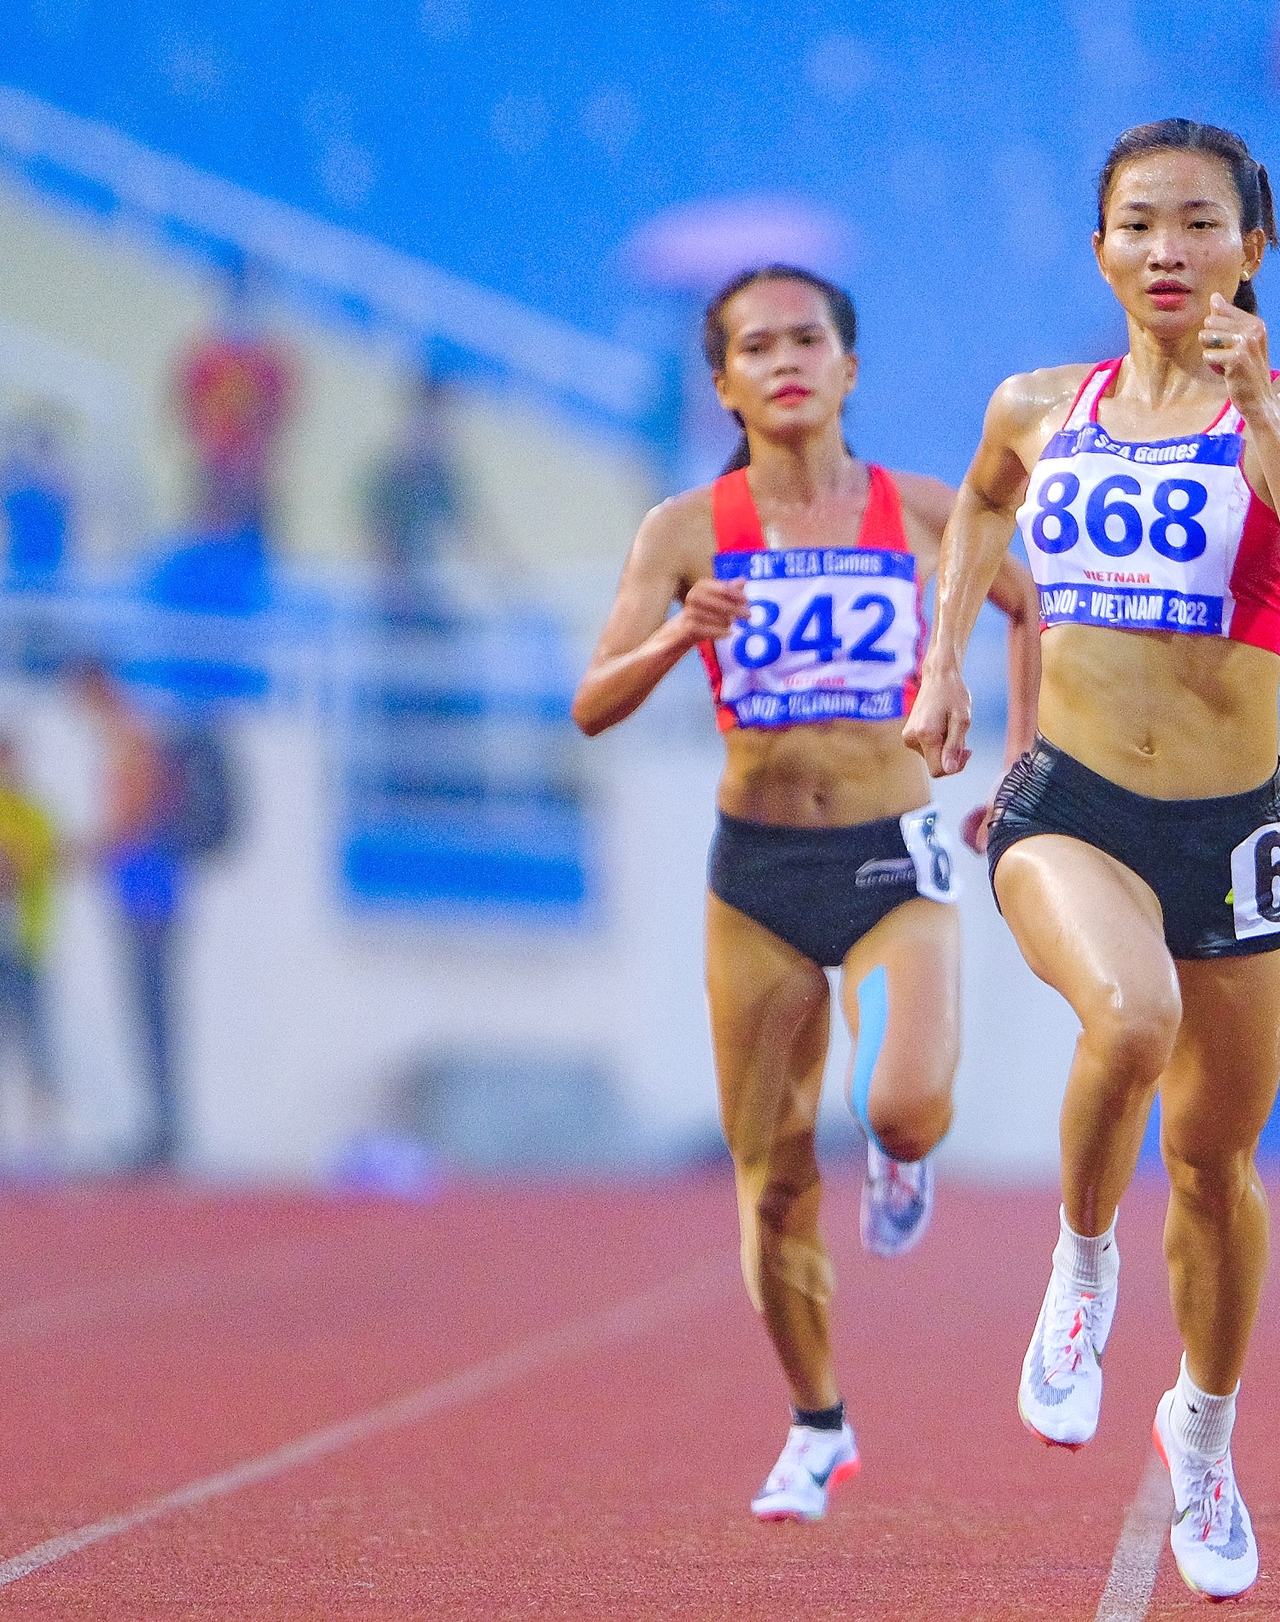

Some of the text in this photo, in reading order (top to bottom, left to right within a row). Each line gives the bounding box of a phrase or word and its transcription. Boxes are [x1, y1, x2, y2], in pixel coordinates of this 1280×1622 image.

[1094, 434, 1131, 458] SEA
[1134, 443, 1199, 462] Games
[1031, 471, 1208, 562] 868
[1083, 570, 1150, 583] VIETNAM
[1091, 591, 1163, 620] VIETNAM
[1166, 598, 1207, 626] 2022
[733, 594, 896, 669] 842
